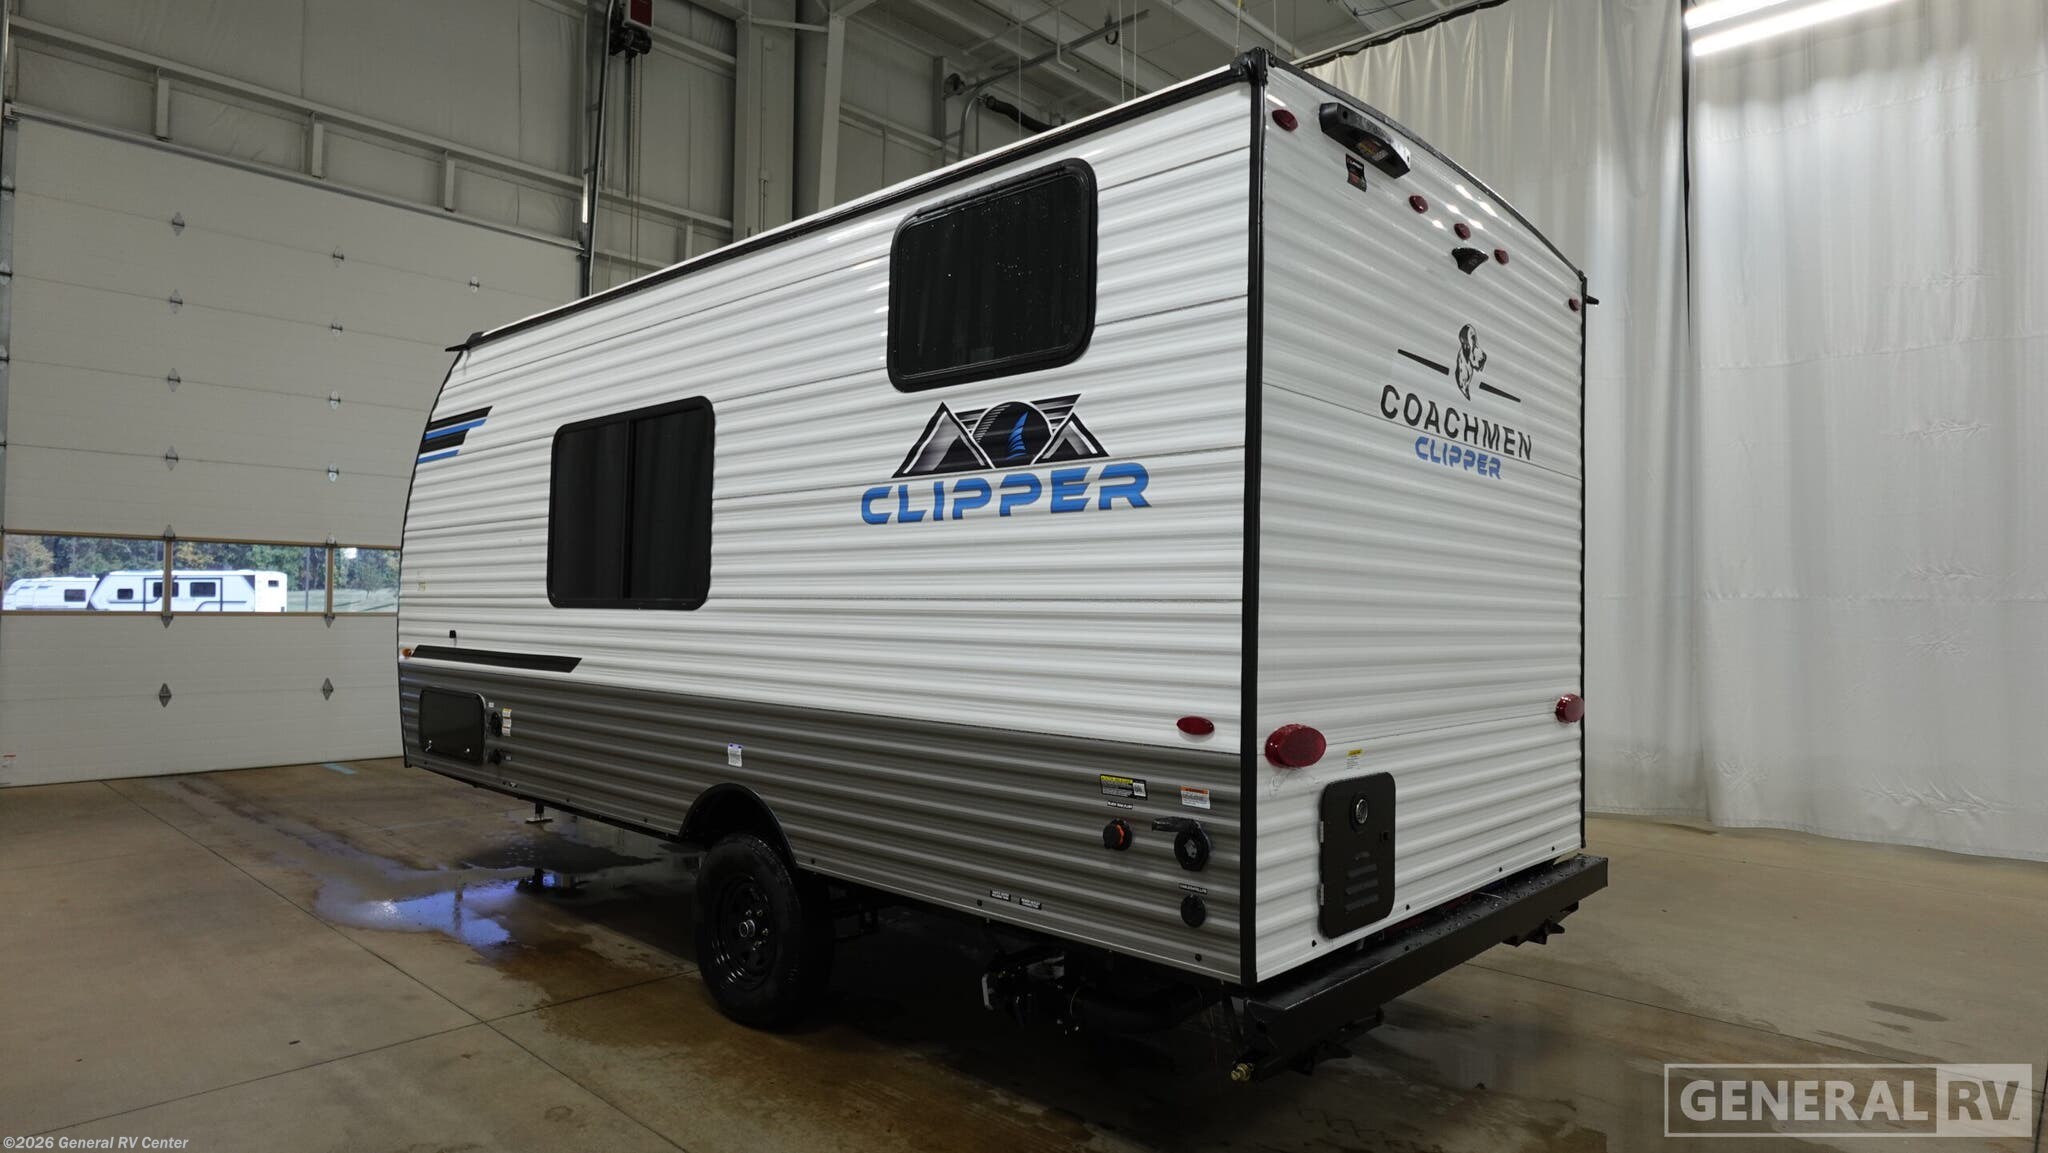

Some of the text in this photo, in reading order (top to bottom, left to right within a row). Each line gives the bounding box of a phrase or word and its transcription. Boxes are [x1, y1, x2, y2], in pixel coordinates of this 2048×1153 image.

[1381, 385, 1532, 460] COACHMEN
[1415, 436, 1501, 479] CLIPPER
[861, 462, 1152, 525] CLIPPER
